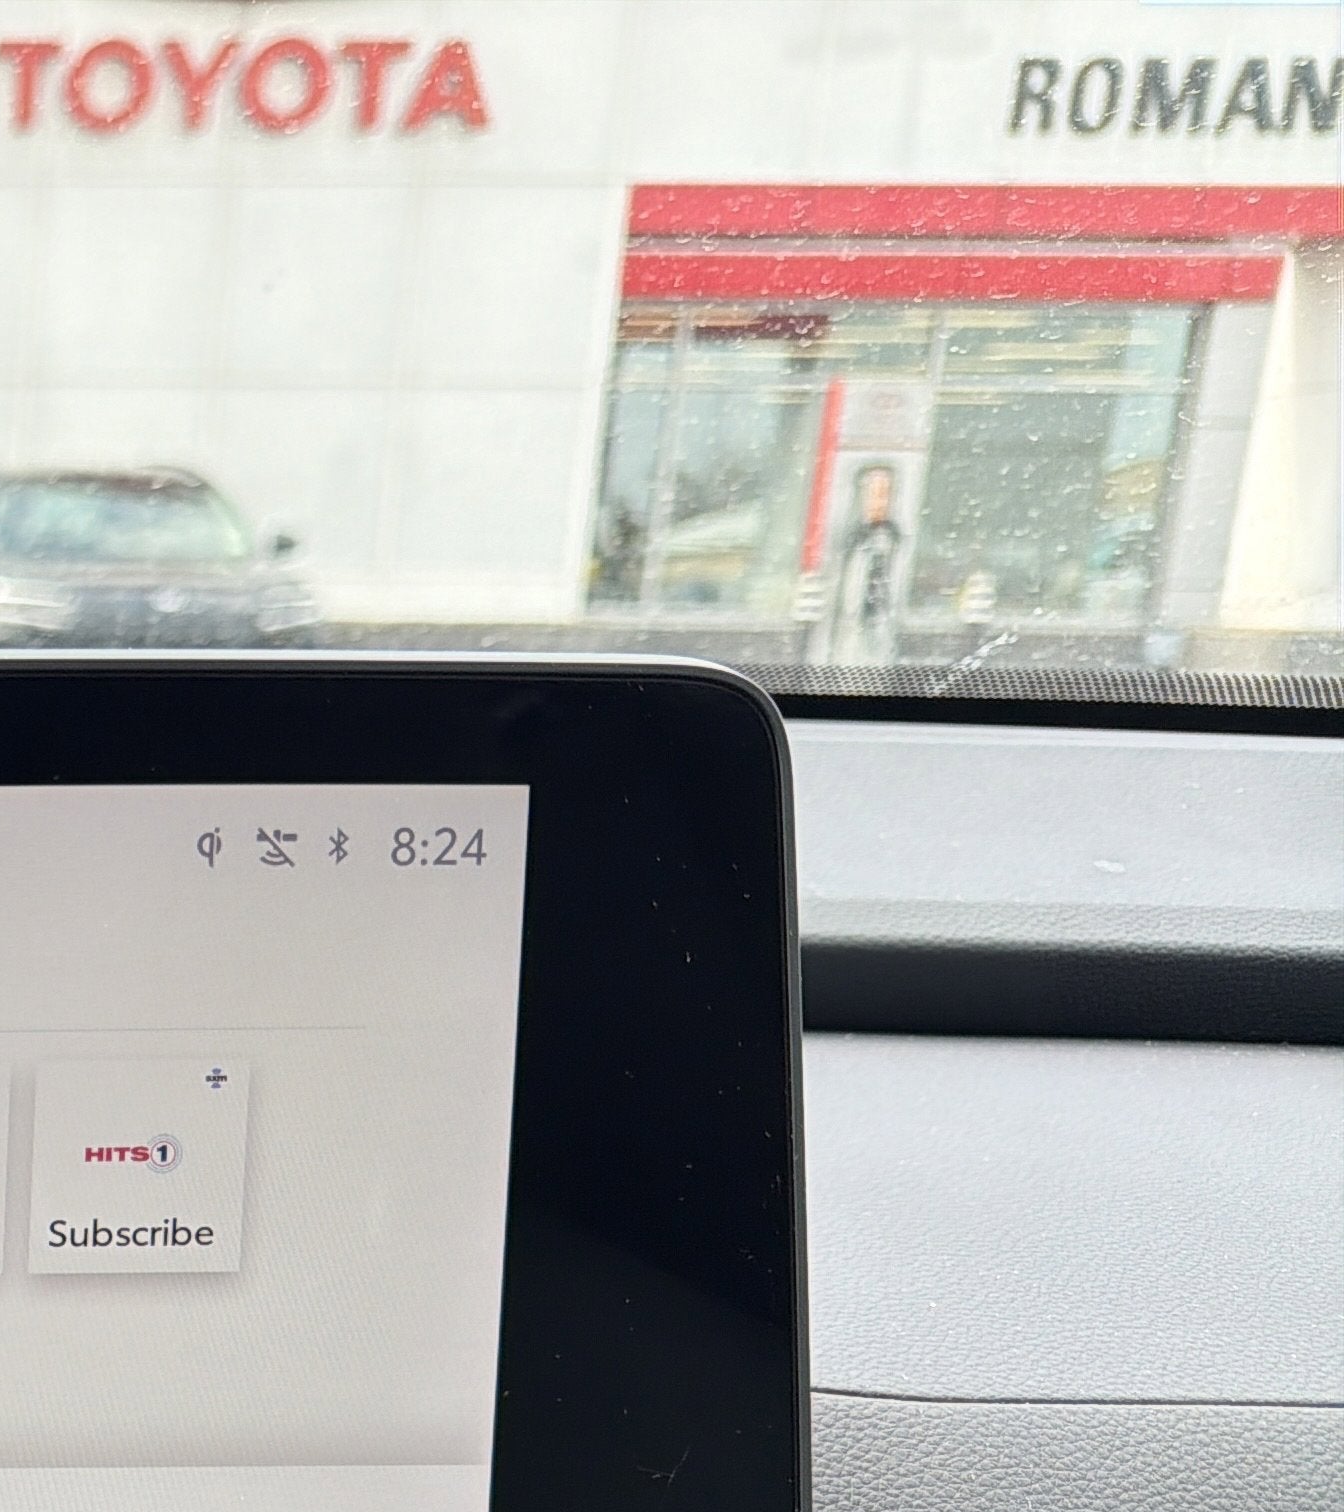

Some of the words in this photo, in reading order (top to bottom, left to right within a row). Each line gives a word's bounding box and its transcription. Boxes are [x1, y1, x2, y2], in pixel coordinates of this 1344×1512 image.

[1007, 54, 1344, 138] ROMAN
[390, 826, 488, 867] 8:24
[84, 1145, 150, 1163] HITS
[48, 1217, 214, 1247] Subscribe
